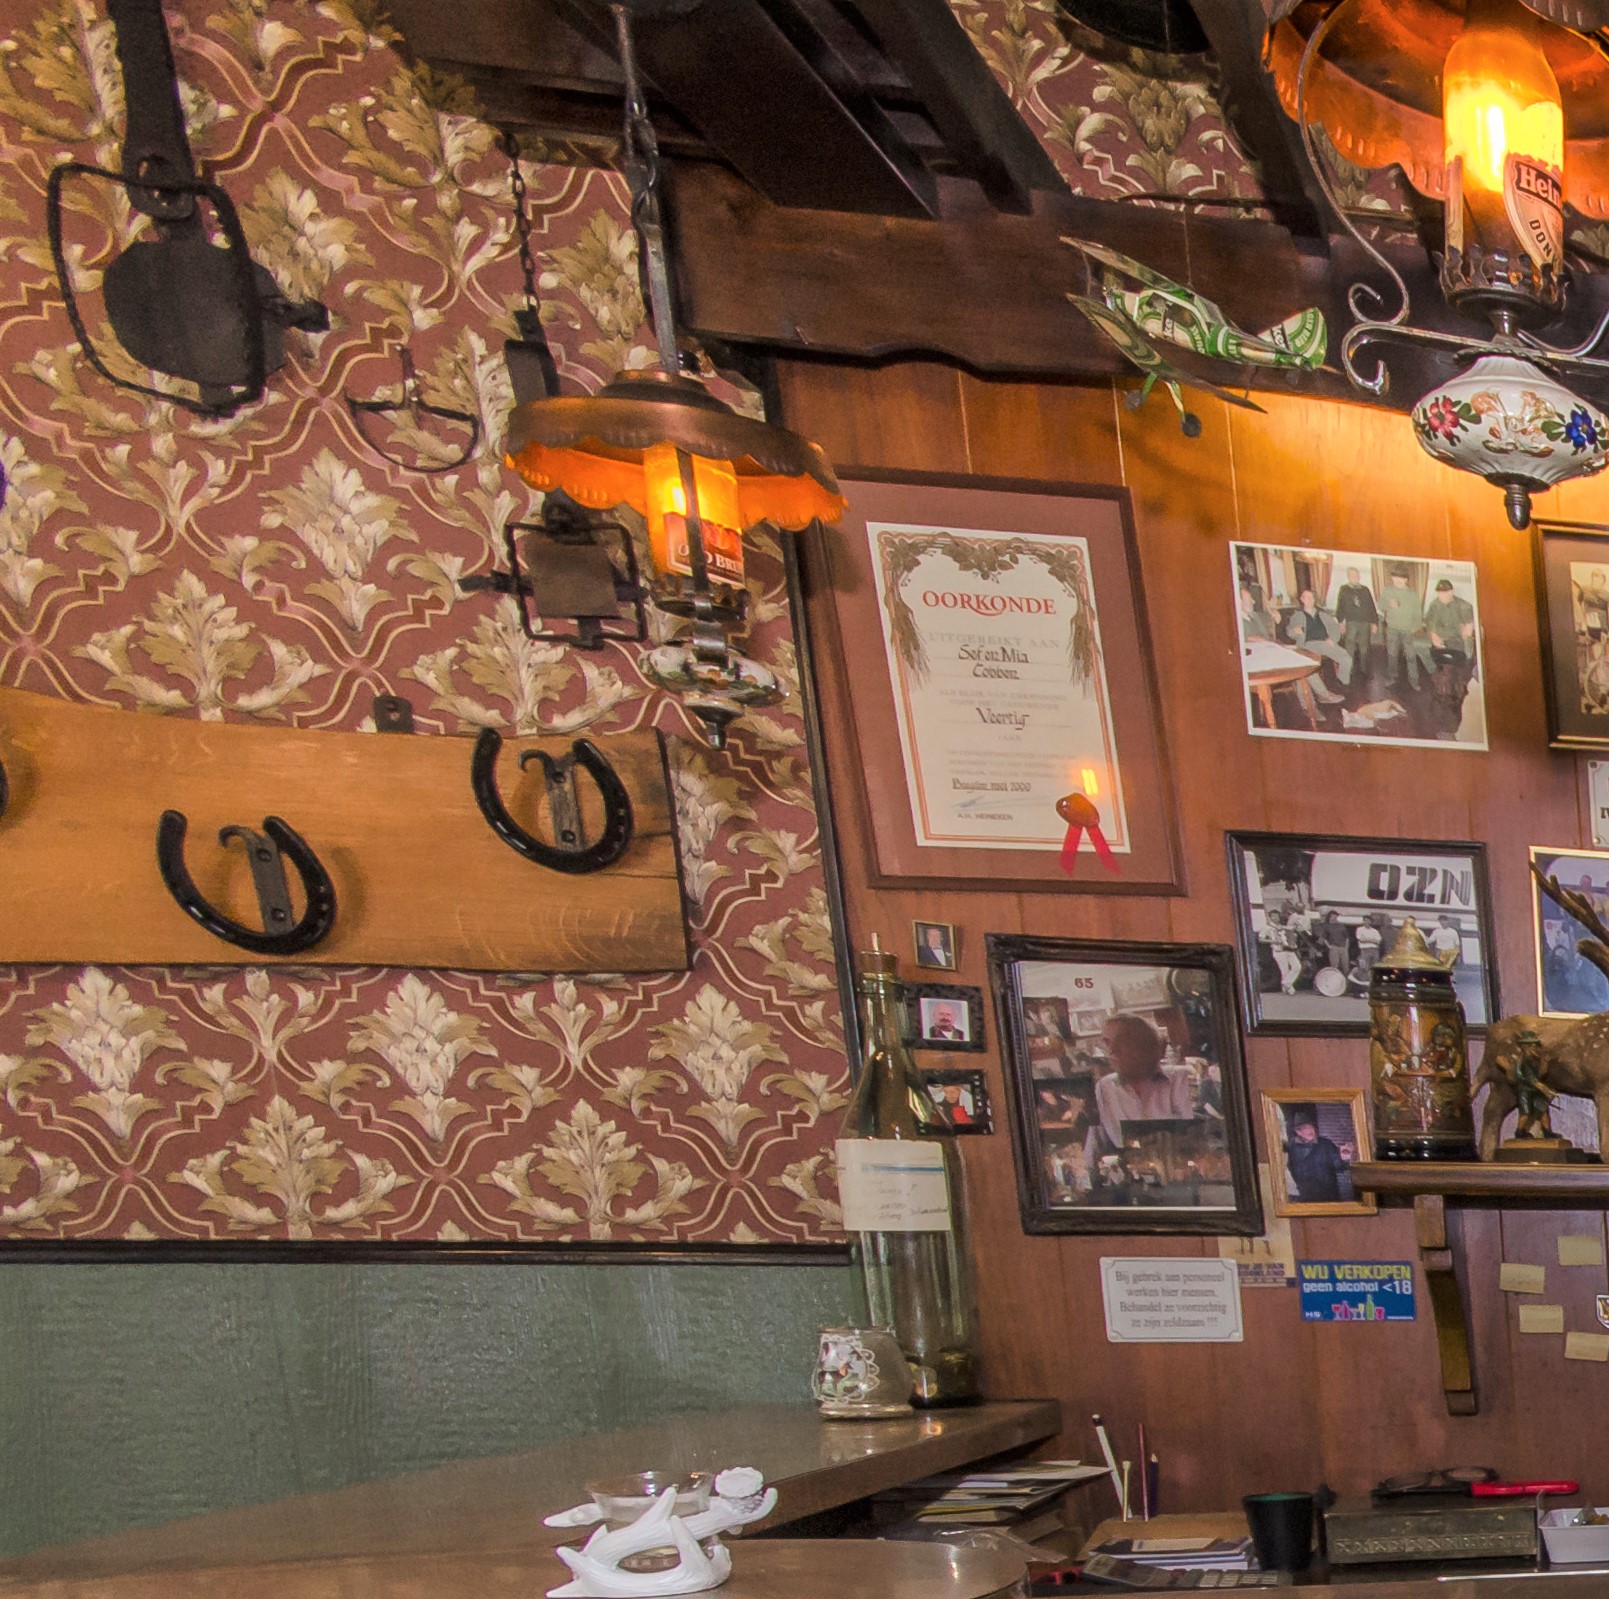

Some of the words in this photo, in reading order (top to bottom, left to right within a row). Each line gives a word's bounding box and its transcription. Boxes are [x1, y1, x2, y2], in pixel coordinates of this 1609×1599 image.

[922, 590, 1057, 617] OORKONDE
[975, 707, 1031, 731] Veertig
[1366, 862, 1472, 906] OZN
[1074, 977, 1094, 989] 65
[1115, 1271, 1130, 1284] Bij
[1132, 1272, 1162, 1285] gebrek
[1183, 1271, 1225, 1285] personeel
[1334, 1264, 1411, 1280] VERKOPEN
[1125, 1287, 1159, 1297] werken
[1161, 1287, 1179, 1297] hier
[1302, 1281, 1333, 1293] geen
[1336, 1281, 1379, 1293] alcohol
[1120, 1301, 1162, 1313] Behandel
